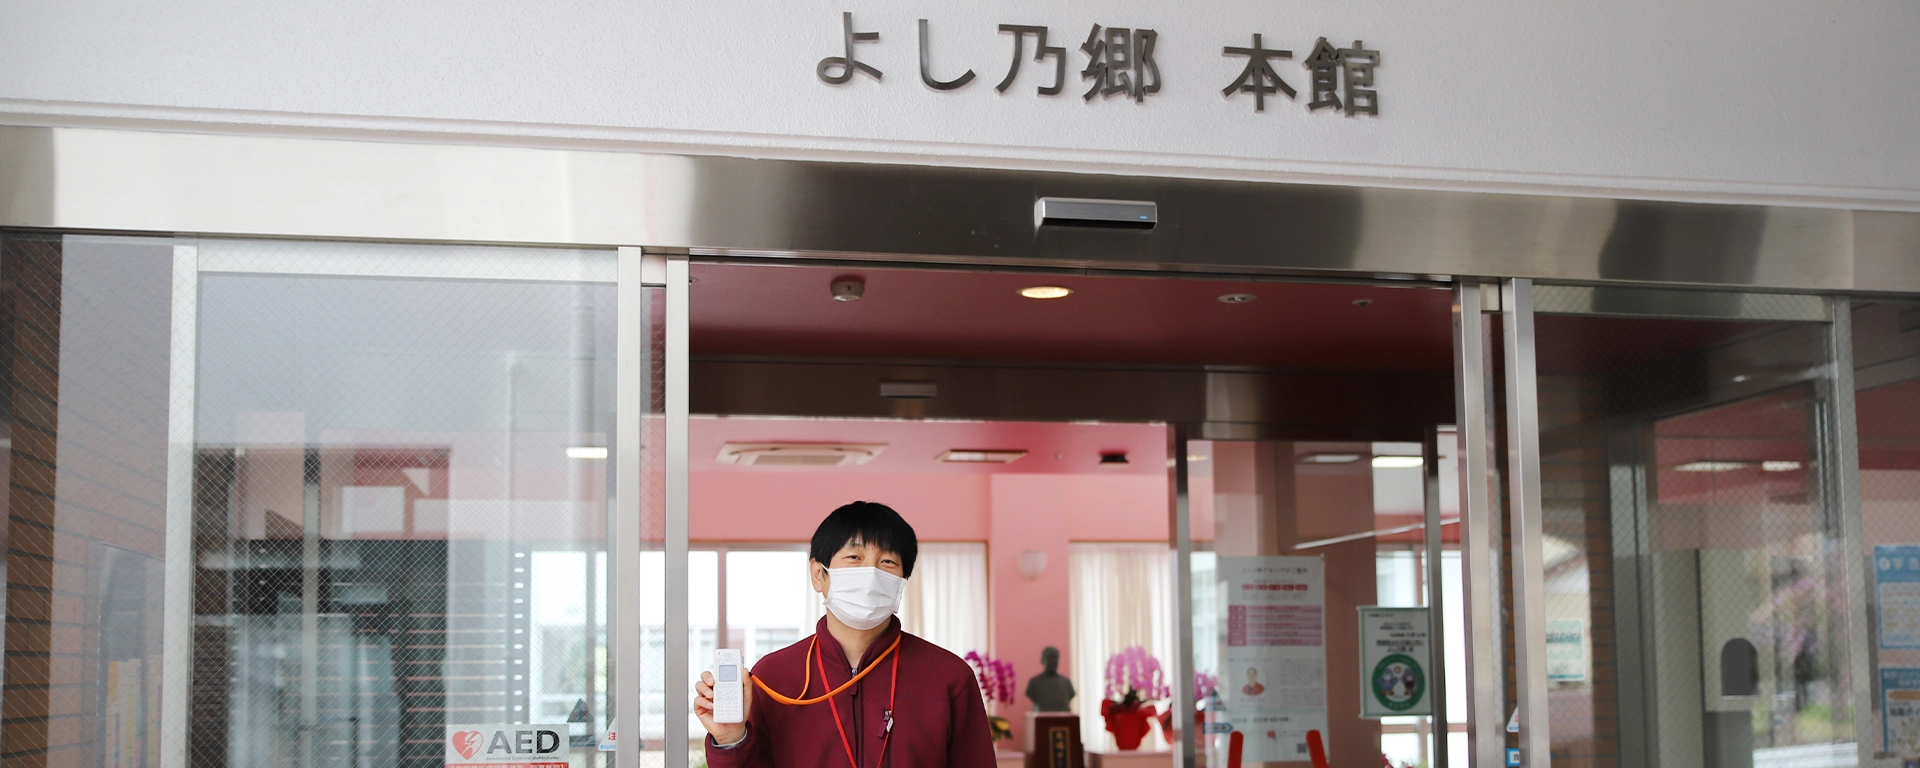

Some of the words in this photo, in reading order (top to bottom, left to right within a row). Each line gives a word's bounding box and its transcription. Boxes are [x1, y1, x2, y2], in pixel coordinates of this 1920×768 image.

[816, 11, 1162, 103] よし乃郷
[1221, 33, 1381, 117] 本館
[486, 730, 560, 754] AED
